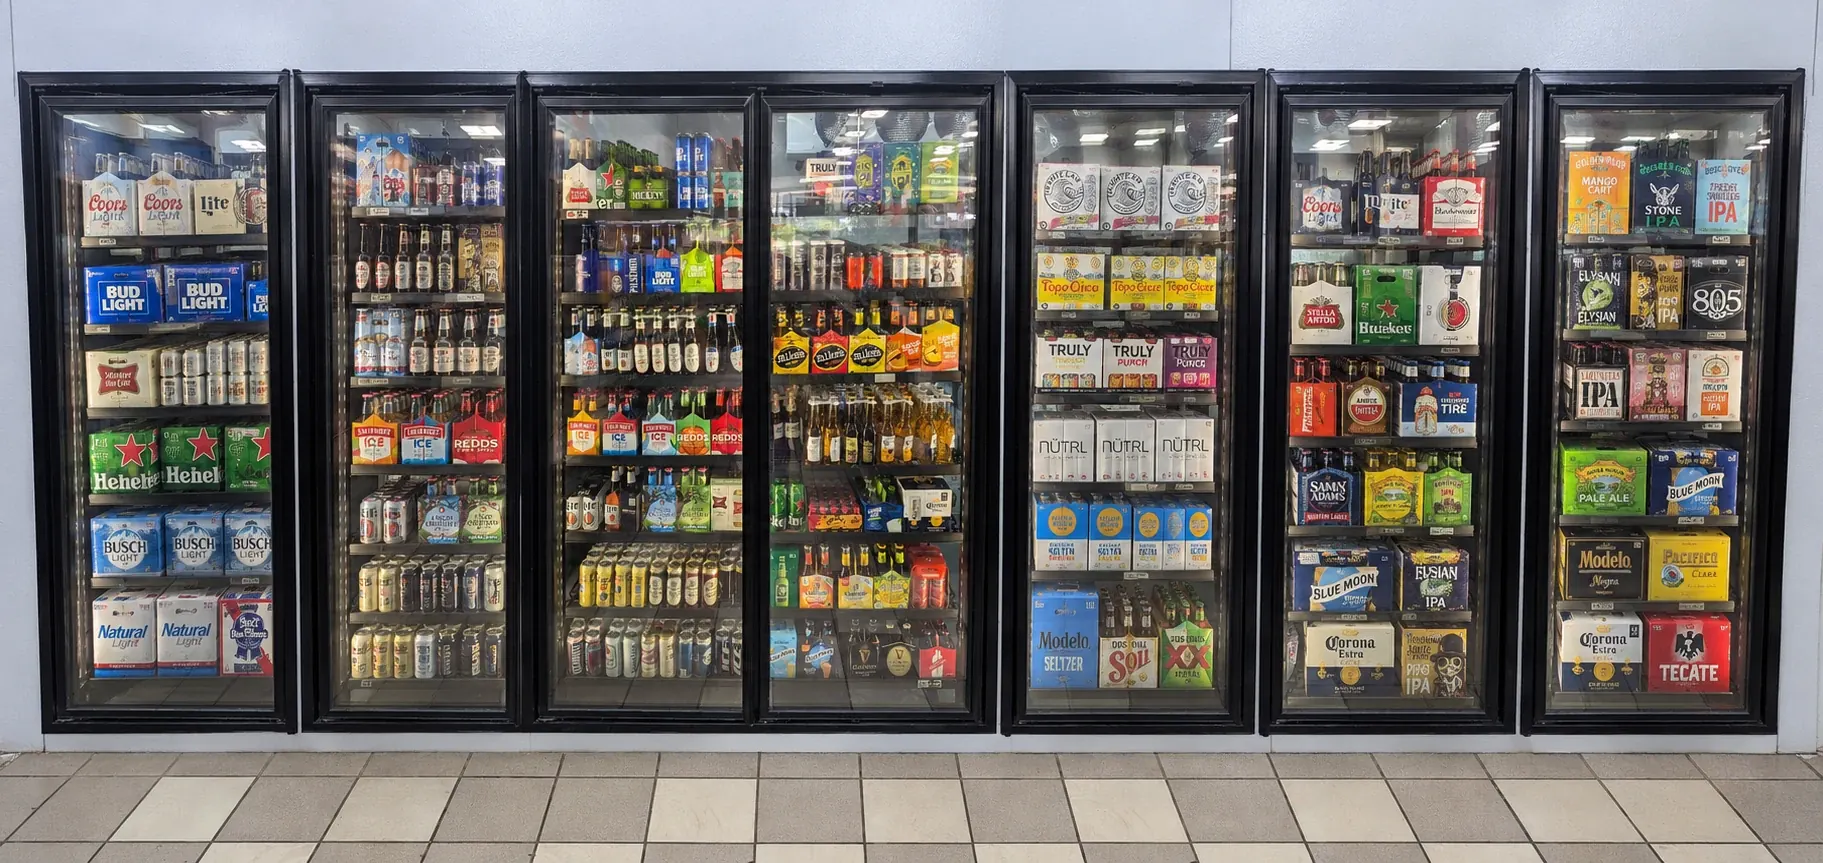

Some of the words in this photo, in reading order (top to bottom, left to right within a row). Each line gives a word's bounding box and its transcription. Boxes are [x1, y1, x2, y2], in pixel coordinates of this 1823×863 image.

[810, 164, 837, 172] TRULY
[1582, 176, 1618, 186] MANGO
[144, 193, 183, 211] Coors
[1644, 206, 1682, 216] STONE
[1708, 202, 1738, 223] IPA
[106, 286, 140, 298] BUD
[186, 283, 223, 296] BUD
[1042, 280, 1068, 295] Topo
[1112, 280, 1136, 294] Topo
[1166, 280, 1188, 294] Topo
[102, 299, 144, 311] LIGHT
[182, 297, 228, 310] LIGHT
[1692, 288, 1742, 315] 805
[1658, 308, 1679, 323] IPA
[1048, 344, 1092, 356] TRULY
[1112, 345, 1155, 358] TRULY
[1172, 345, 1211, 358] TRULY
[1581, 382, 1619, 408] IPA
[1440, 403, 1467, 414] TIRE
[1708, 403, 1721, 412] IPA
[414, 439, 432, 448] ICE
[612, 434, 626, 442] ICE
[651, 433, 666, 441] ICE
[1310, 491, 1346, 502] ADAMS
[1579, 494, 1606, 503] PALE
[1608, 494, 1630, 502] ALE
[1670, 486, 1694, 500] BLUE
[104, 541, 147, 554] BUSCH
[174, 538, 215, 550] BUSCH
[233, 538, 272, 550] BUSCH
[1578, 550, 1630, 568] Modelo
[1344, 574, 1375, 590] MOON
[1426, 596, 1446, 608] IPA
[98, 625, 148, 638] Natural
[162, 623, 212, 637] Natural
[1038, 631, 1088, 650] Modelo
[1326, 635, 1376, 652] Corona
[1580, 632, 1627, 648] Corona
[1044, 656, 1083, 672] SELTZER
[1165, 645, 1211, 670] XX
[1660, 664, 1719, 682] TECATE
[1406, 678, 1431, 695] IPA
